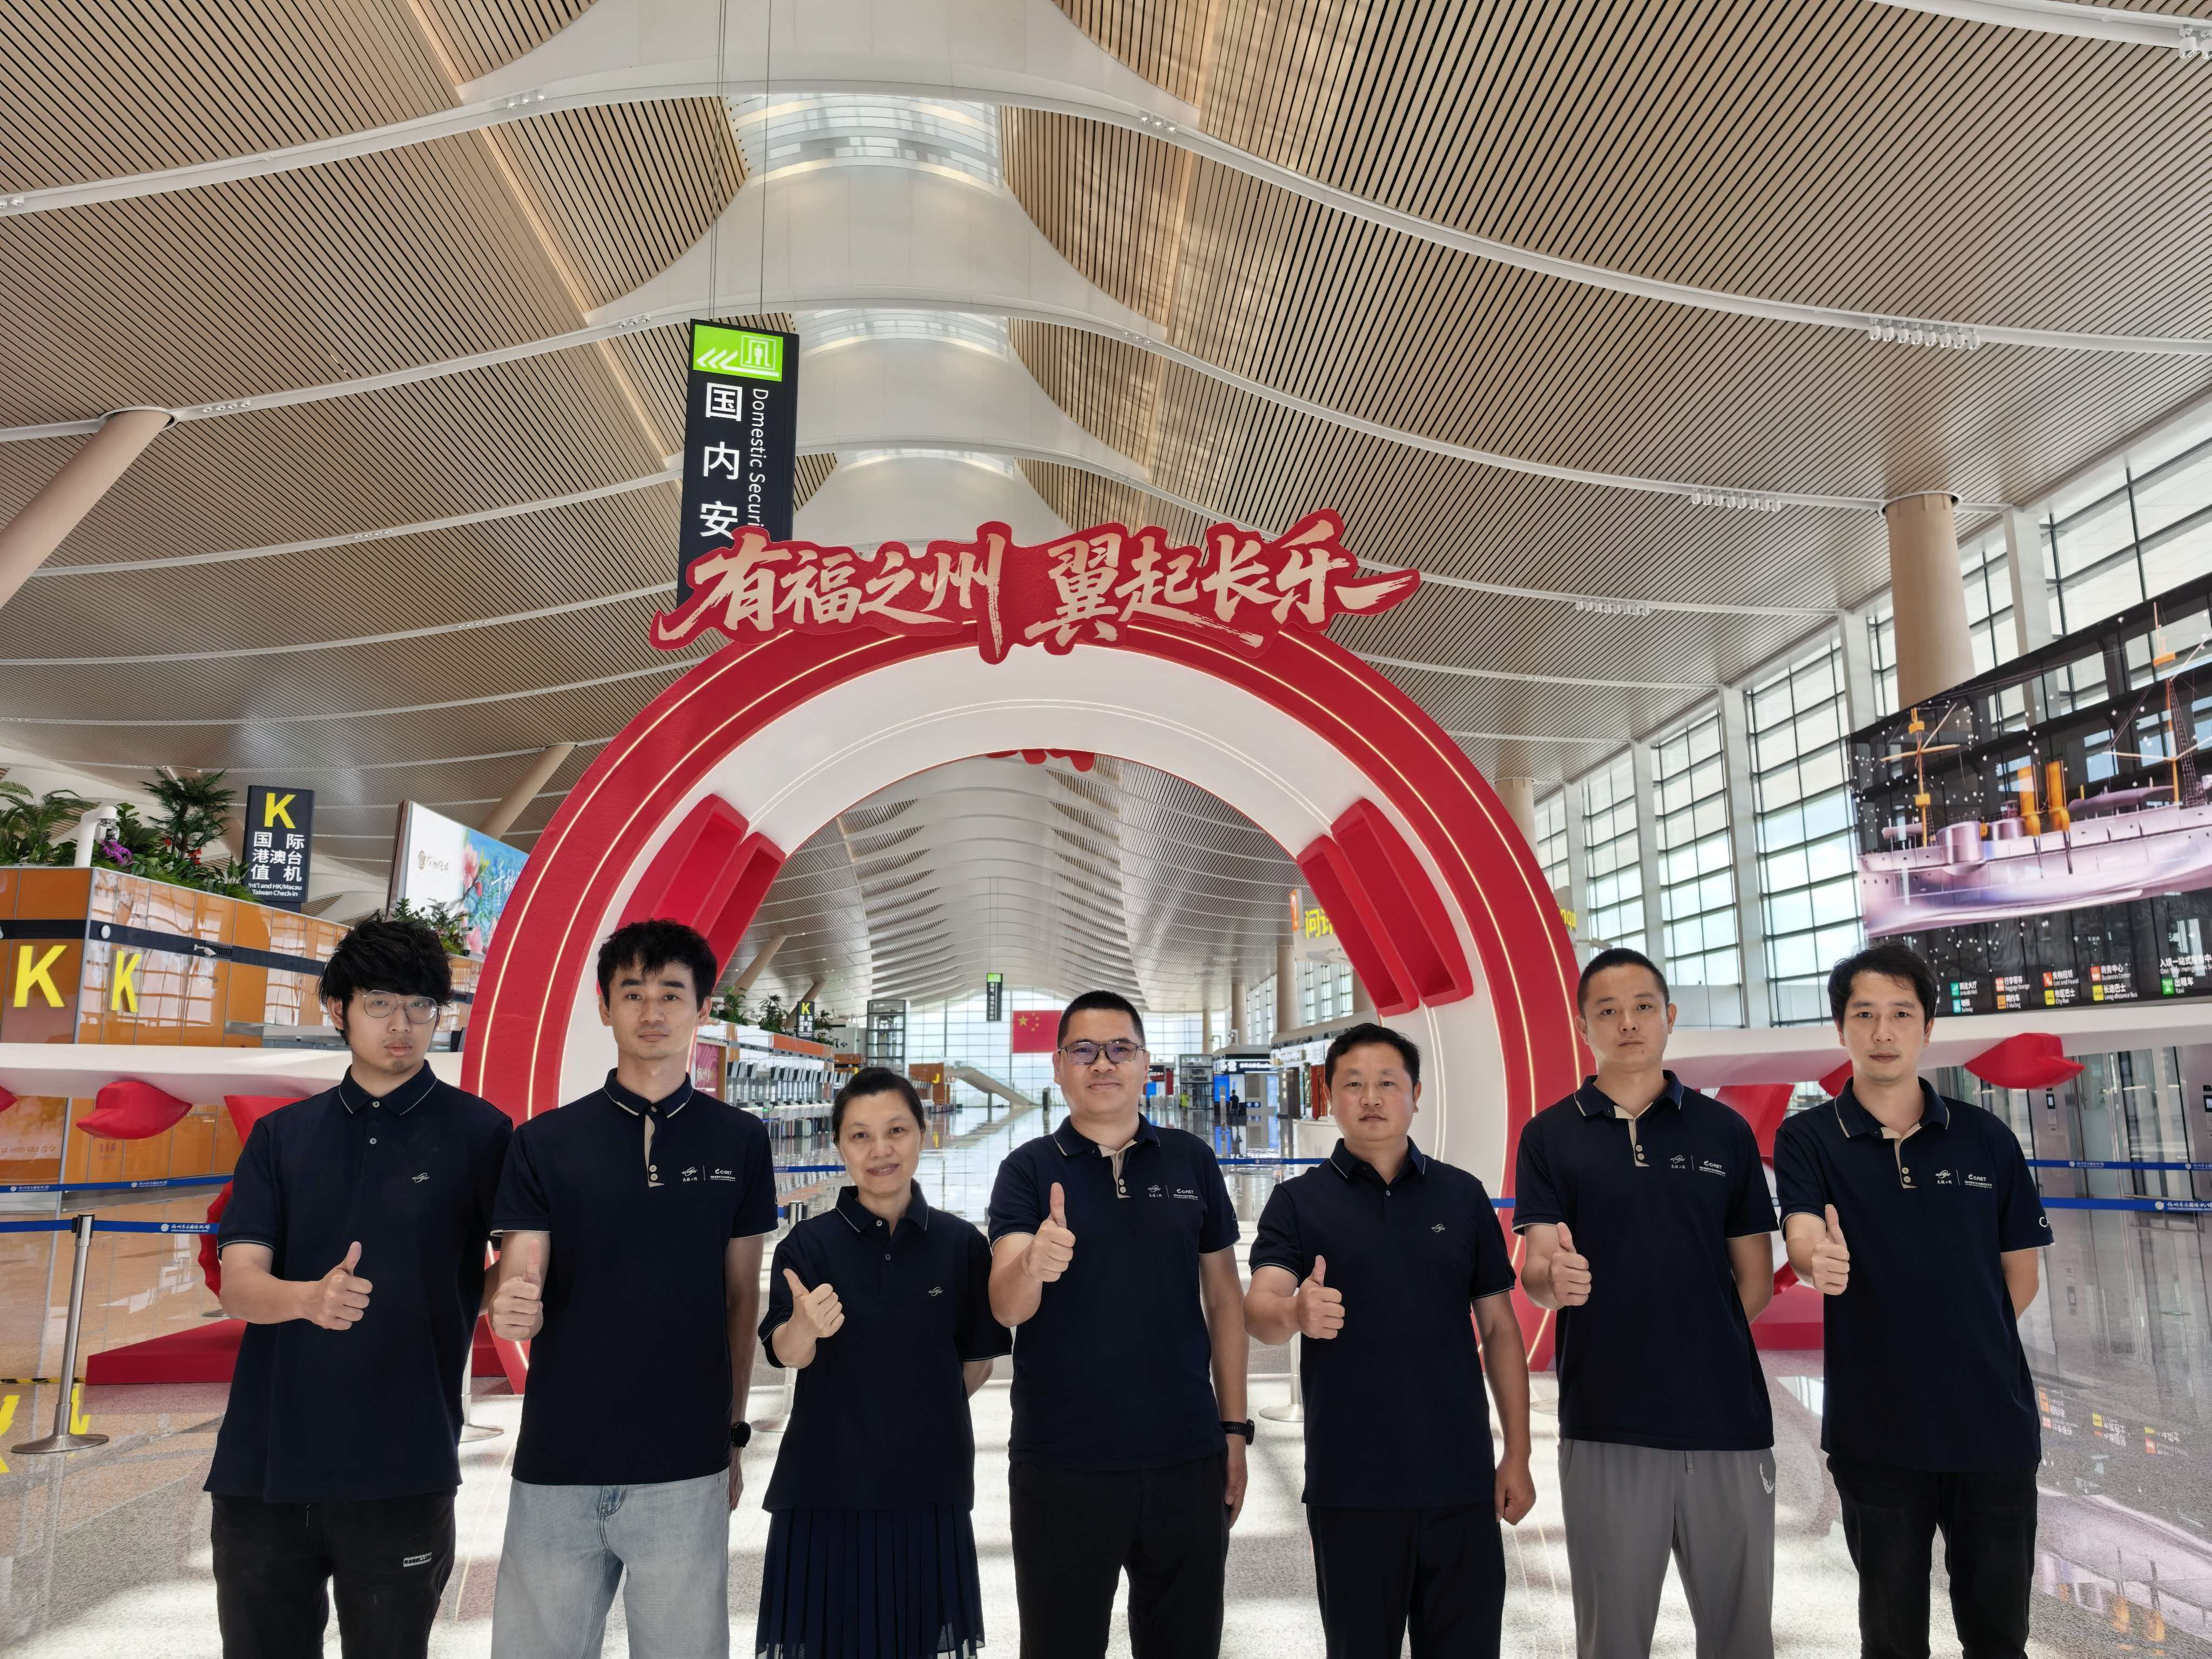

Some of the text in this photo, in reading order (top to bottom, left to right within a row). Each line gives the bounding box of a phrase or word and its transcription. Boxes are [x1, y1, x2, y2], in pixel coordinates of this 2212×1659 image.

[700, 382, 743, 540] 国内安
[747, 388, 769, 527] Domestic Securi
[658, 519, 1413, 659] 有福之州 翼起长乐
[264, 792, 296, 829] K
[251, 864, 302, 882] 值机
[252, 848, 303, 865] 港澳台
[14, 945, 68, 1008] K
[111, 950, 142, 1013] K
[801, 1002, 811, 1015] K
[933, 1073, 940, 1084] J
